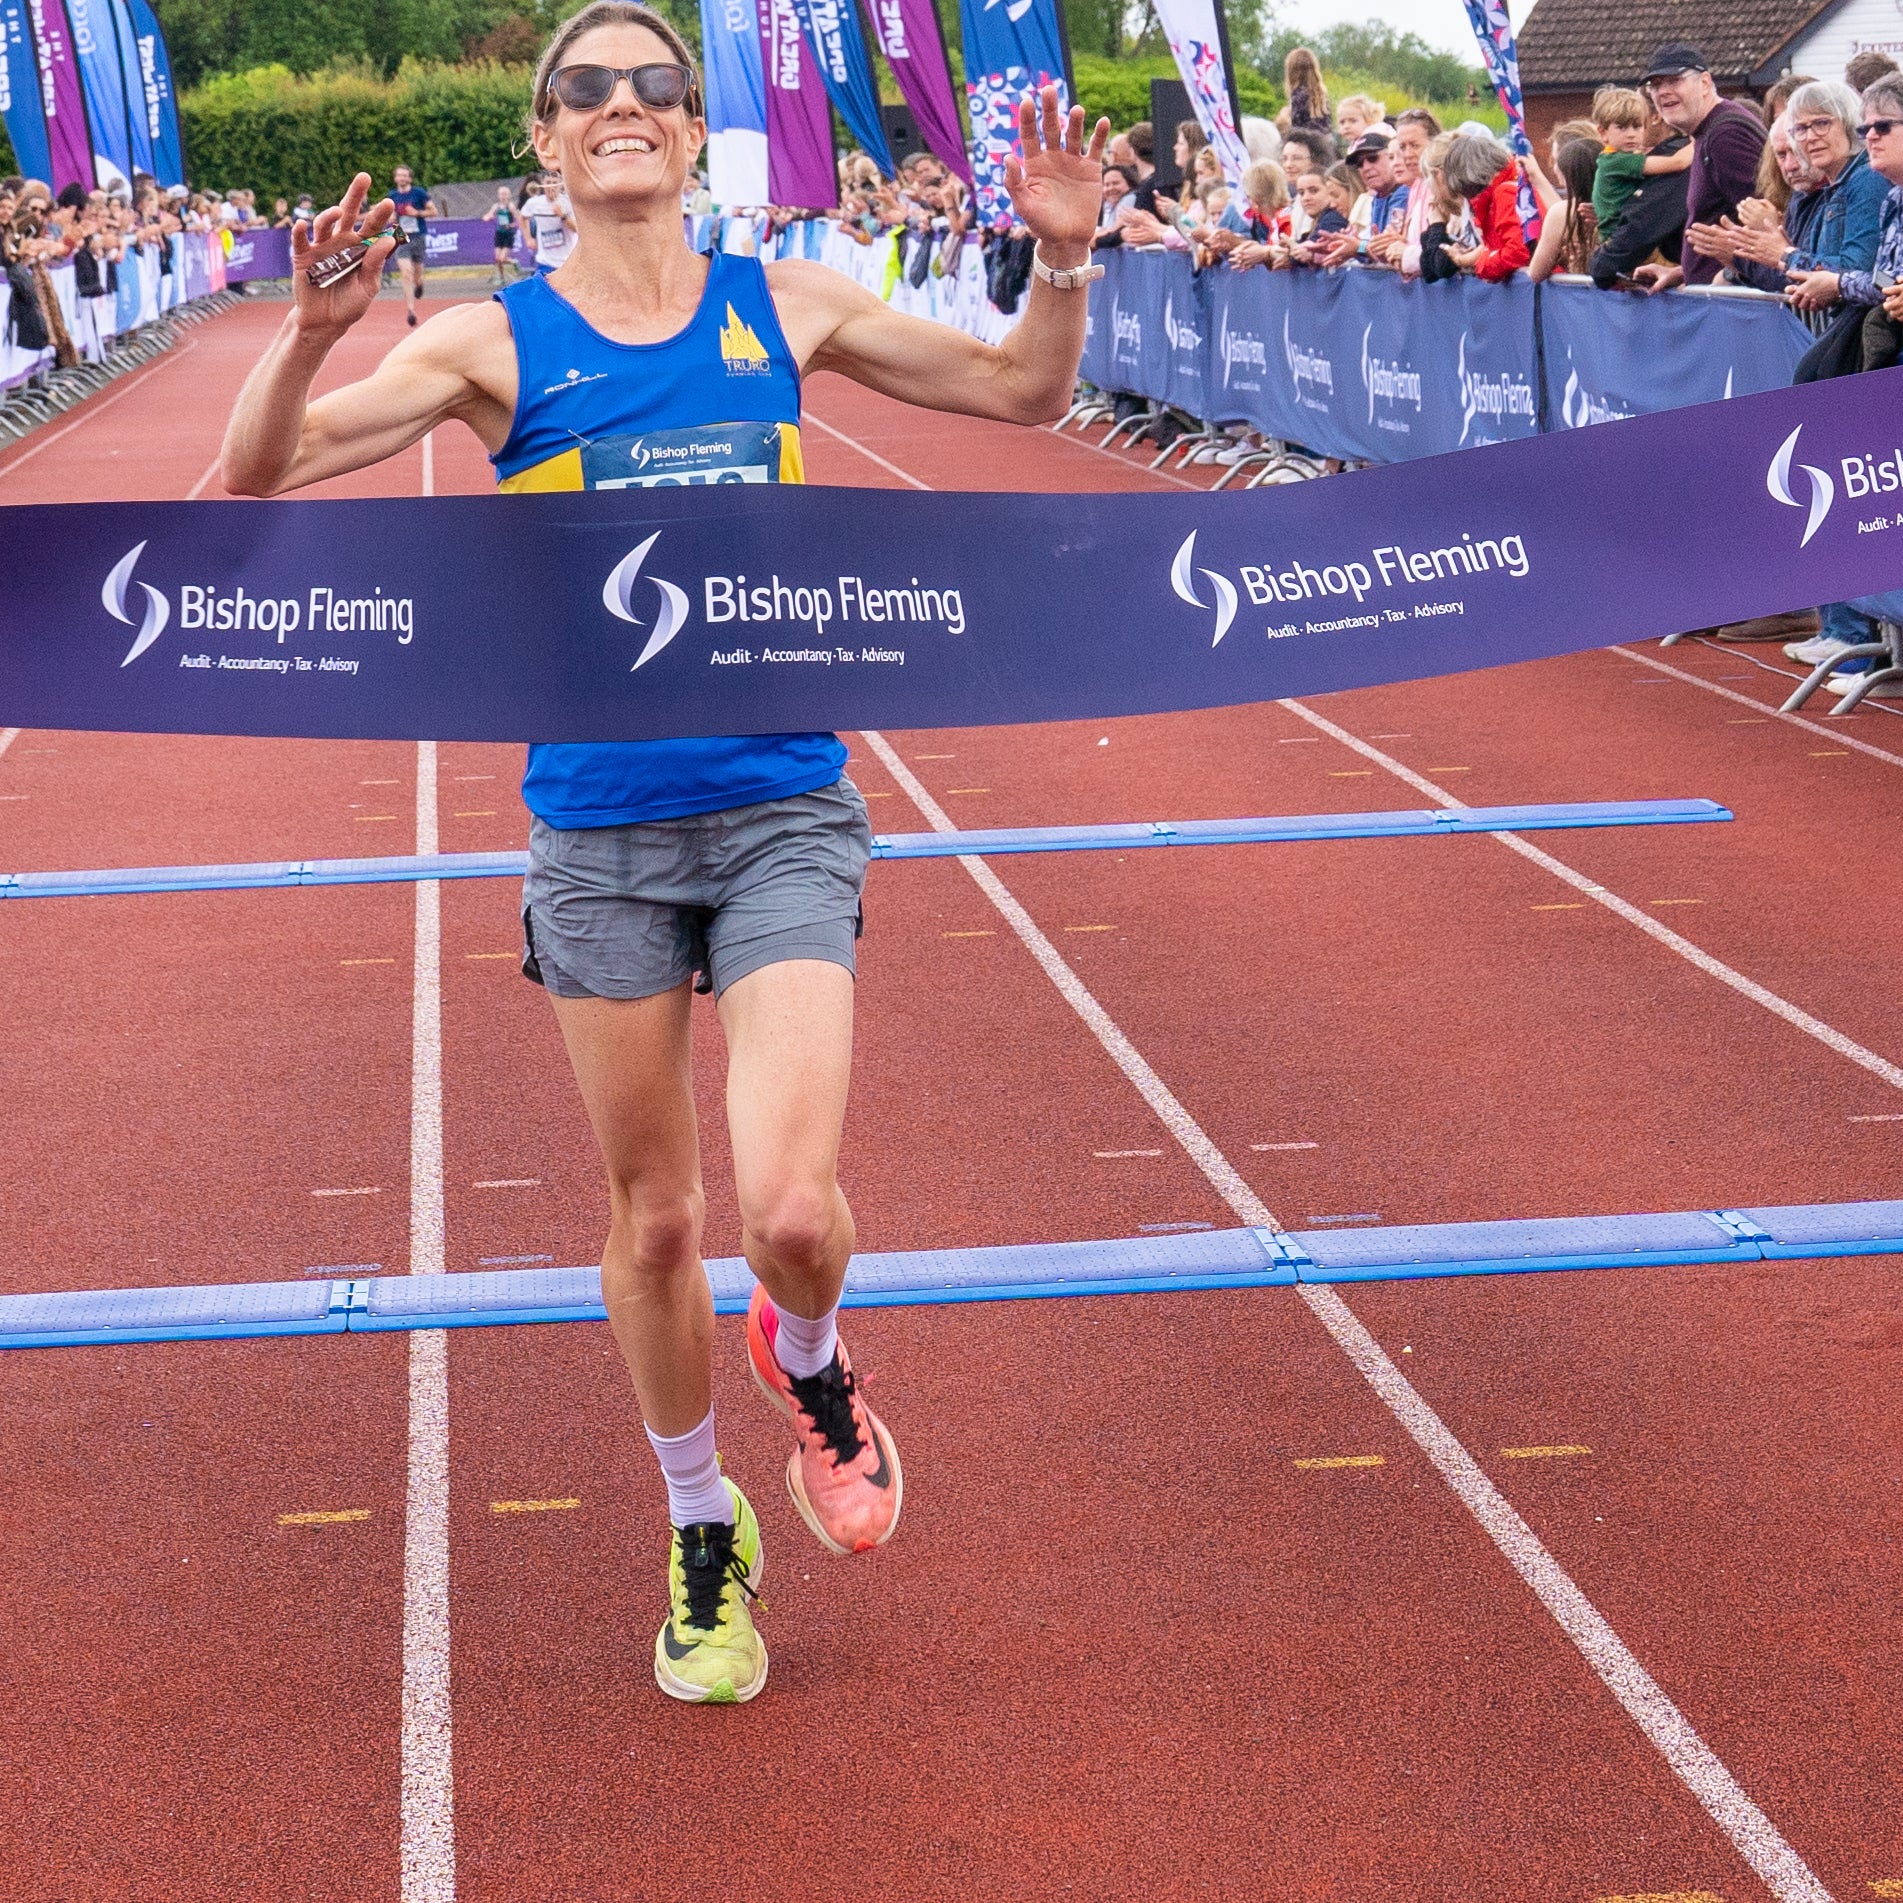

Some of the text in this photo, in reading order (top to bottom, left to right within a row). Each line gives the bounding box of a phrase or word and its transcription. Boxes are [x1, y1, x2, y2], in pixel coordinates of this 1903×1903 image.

[652, 442, 732, 459] Bishop Fleming
[1857, 516, 1889, 535] Audit
[1240, 533, 1529, 604] Bishop Fleming
[181, 586, 413, 644] Bishop Fleming
[705, 575, 965, 634] Bishop Fleming
[1267, 599, 1464, 640] Audit Accountancy Tax Advisory
[180, 653, 359, 675] Audit Accountancy Tax Advisory
[710, 647, 905, 666] Audit Accountancy Tax Advisory
